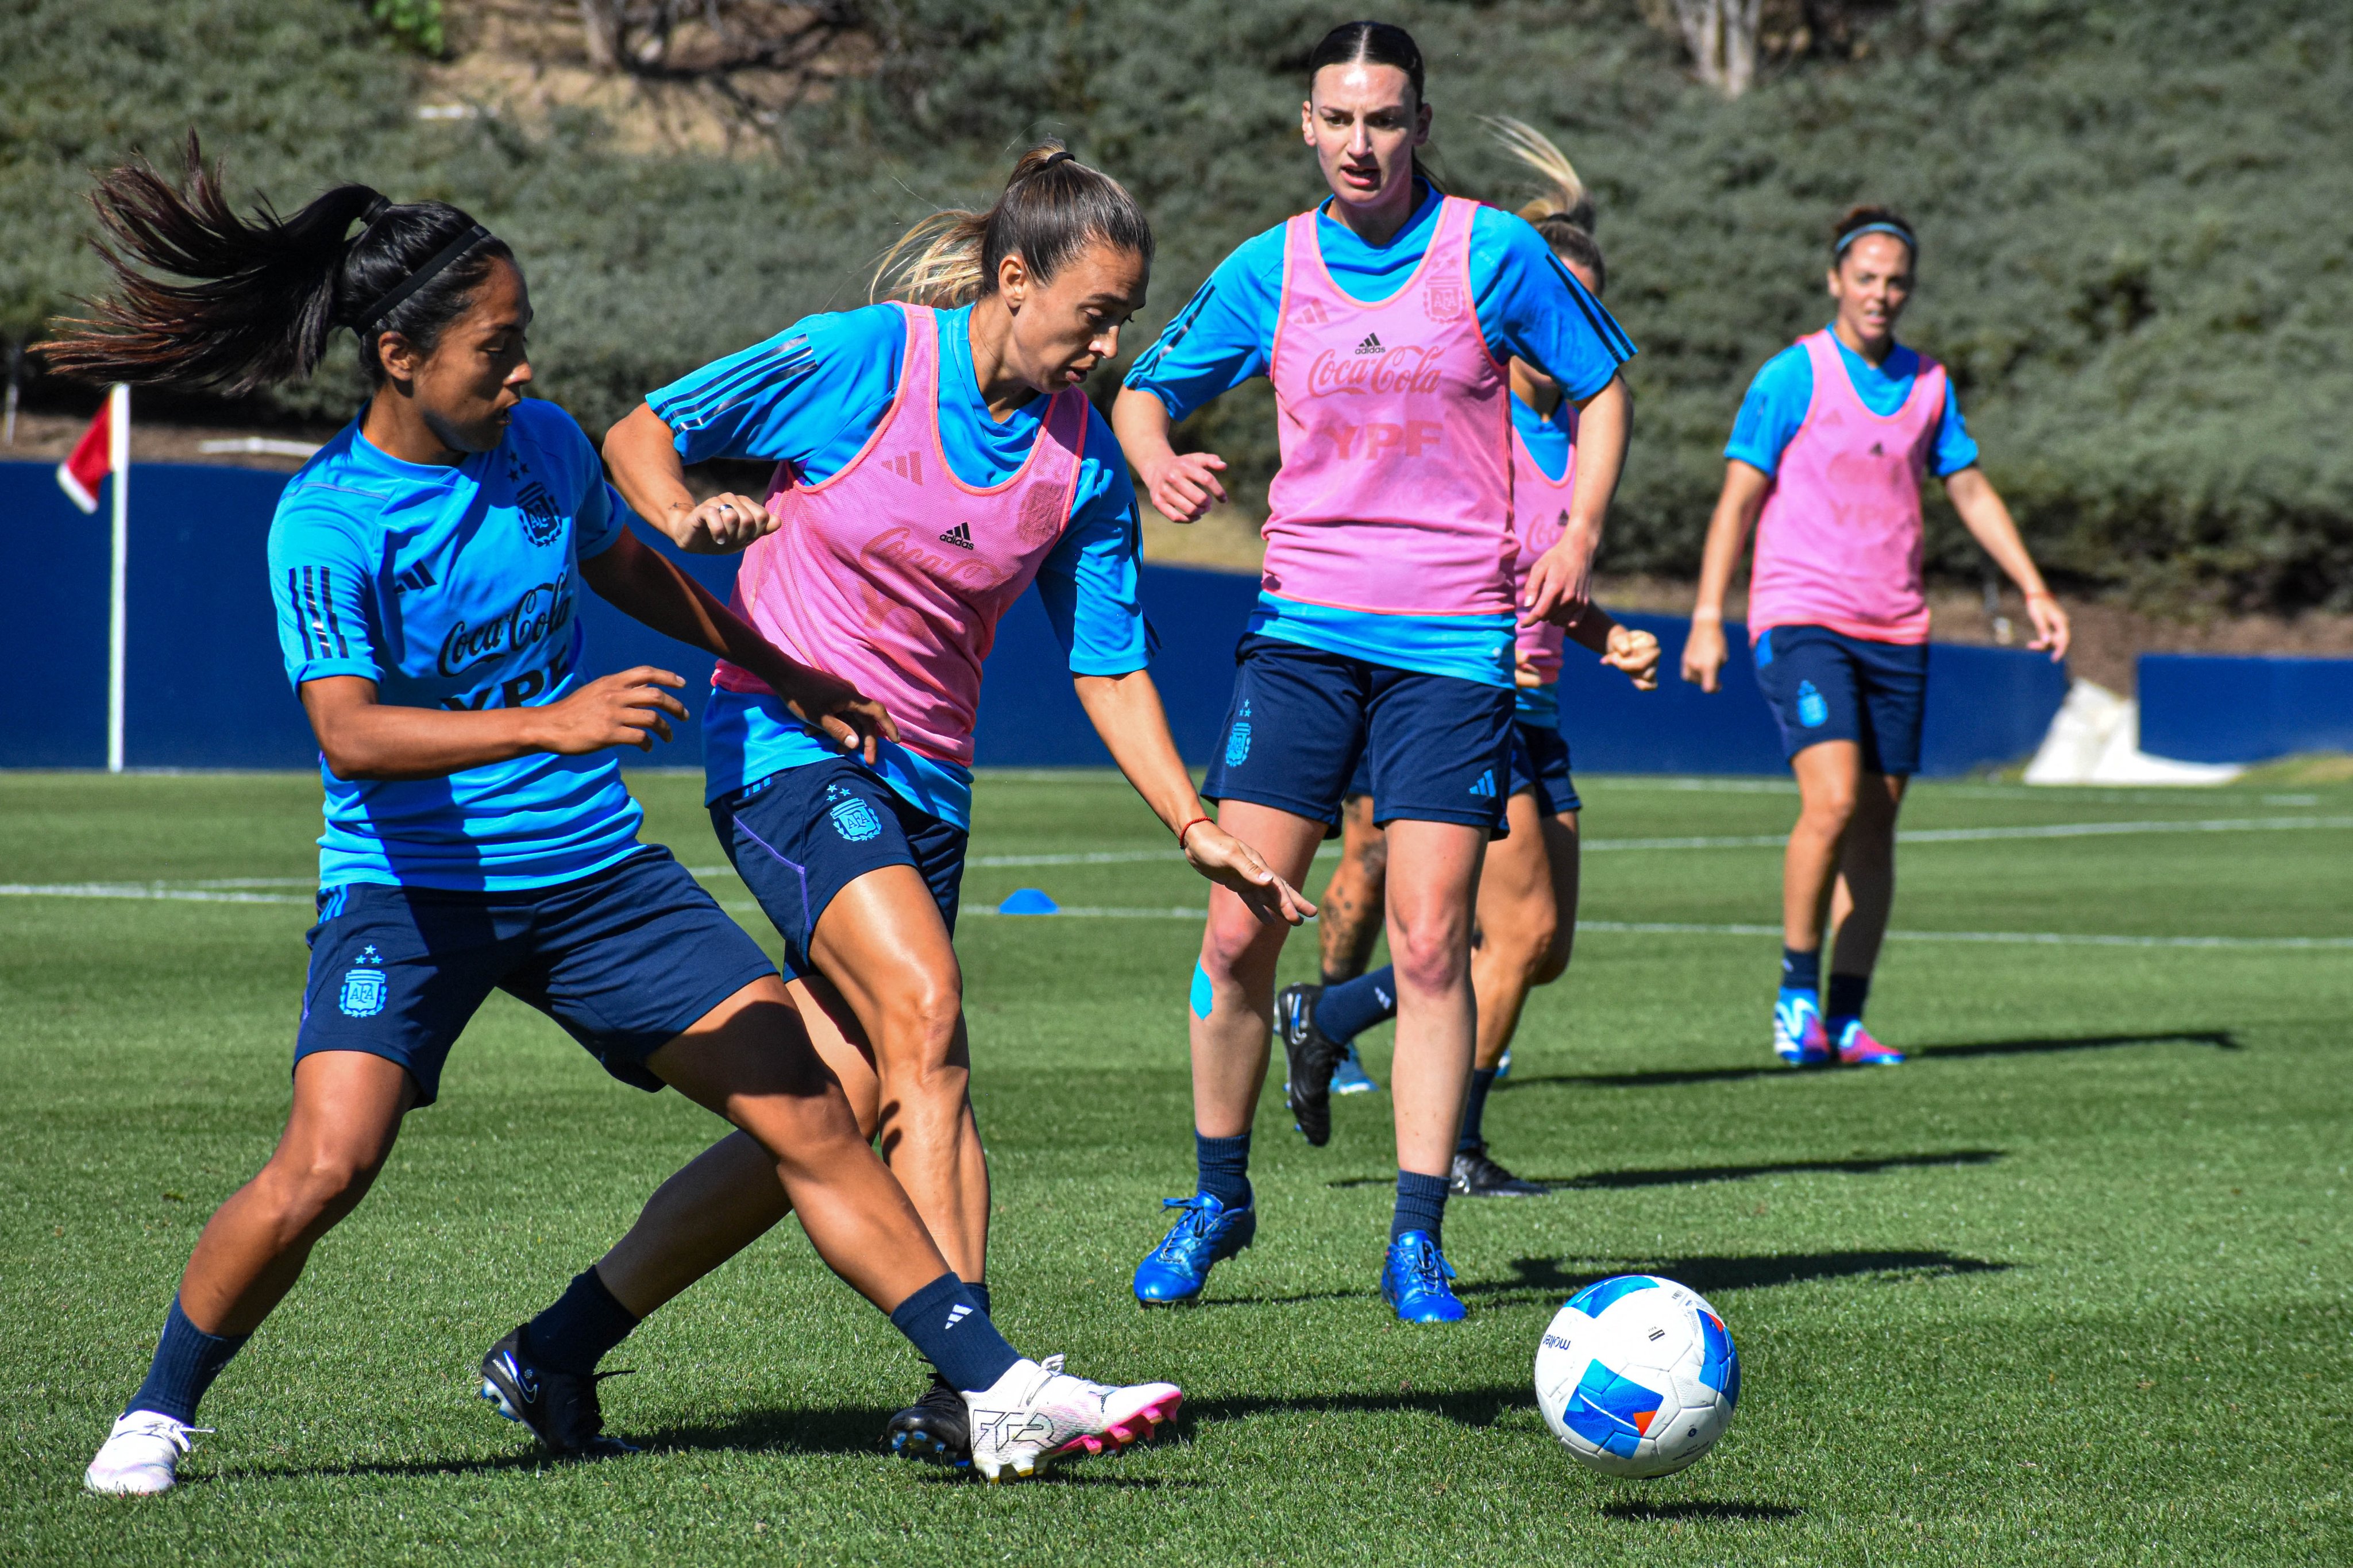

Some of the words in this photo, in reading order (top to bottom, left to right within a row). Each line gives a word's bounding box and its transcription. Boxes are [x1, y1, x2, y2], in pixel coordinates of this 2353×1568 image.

[1355, 346, 1386, 355] adidas
[1308, 345, 1446, 397] Coca-Cola
[1323, 420, 1443, 460] YPF
[939, 533, 974, 550] adidas
[438, 565, 571, 678] Coca-Cola
[844, 809, 870, 829] AFA
[349, 983, 375, 1003] AFA
